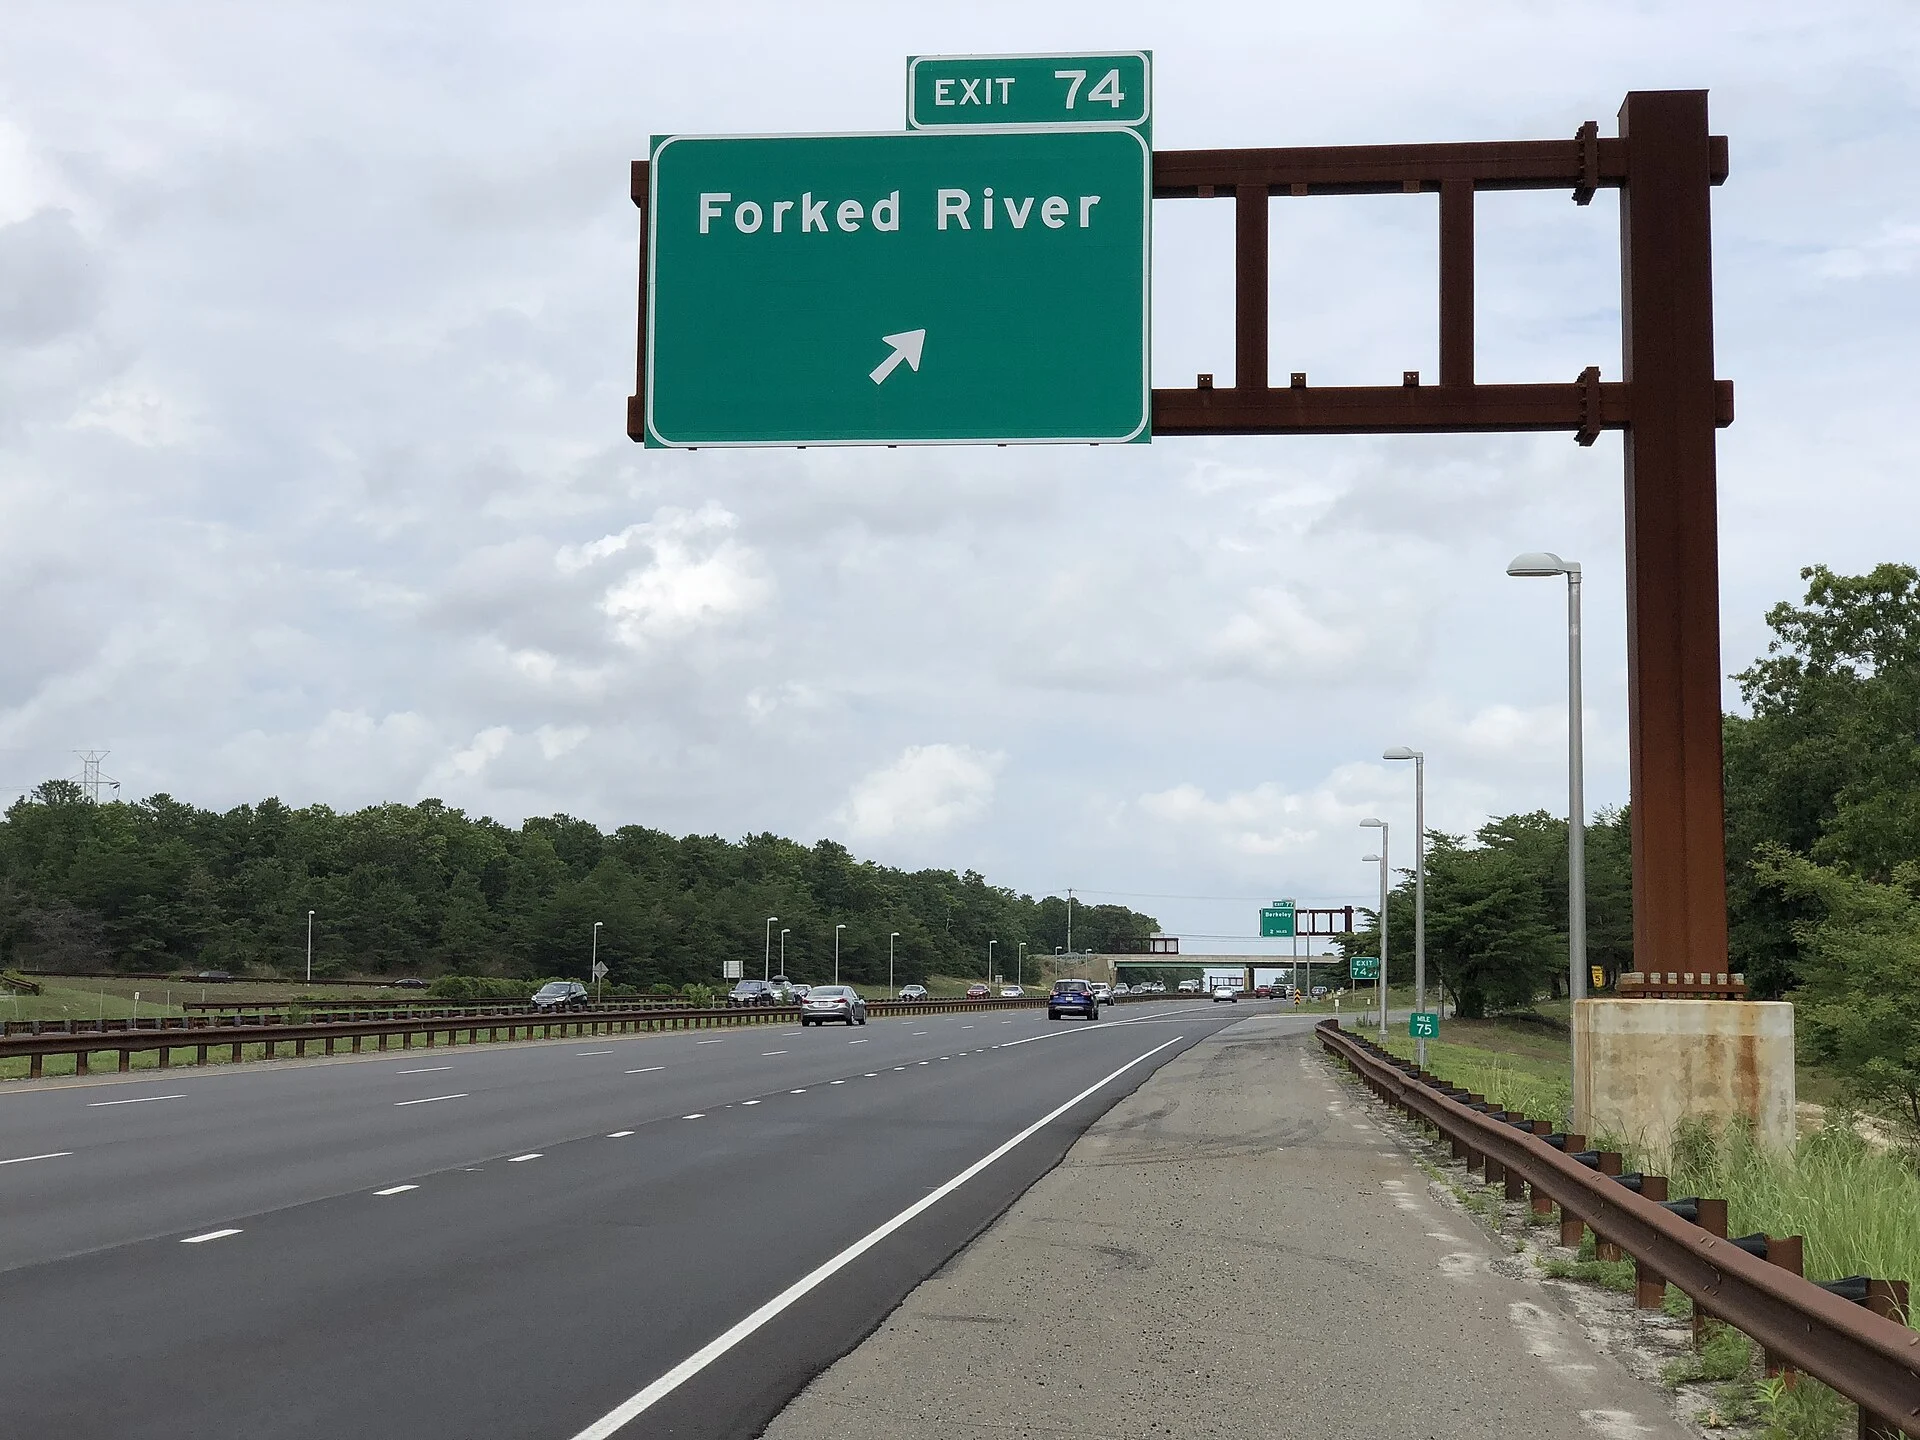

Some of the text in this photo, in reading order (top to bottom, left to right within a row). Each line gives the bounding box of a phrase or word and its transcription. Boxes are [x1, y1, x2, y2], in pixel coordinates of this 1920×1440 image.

[935, 69, 1125, 109] EXIT 74
[699, 187, 1101, 234] Forked River
[1416, 1015, 1431, 1023] MILE
[1416, 1023, 1432, 1035] 75
